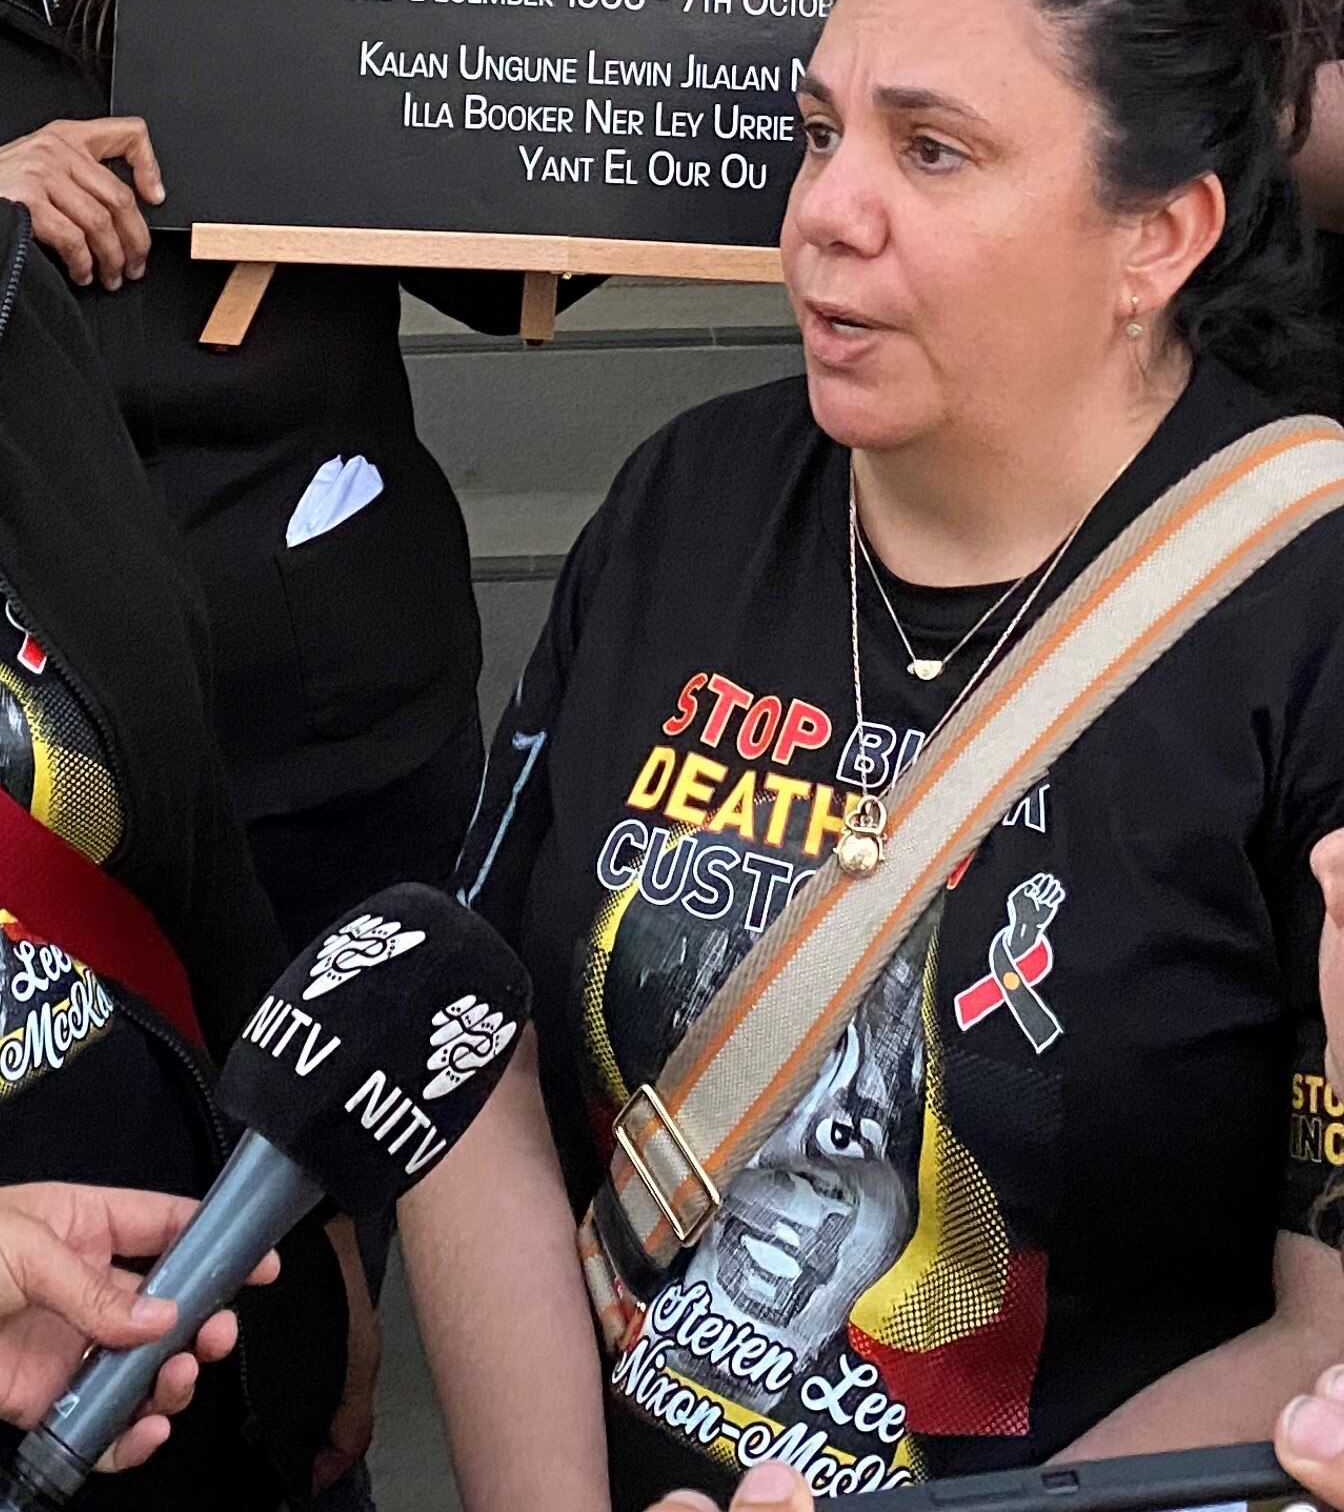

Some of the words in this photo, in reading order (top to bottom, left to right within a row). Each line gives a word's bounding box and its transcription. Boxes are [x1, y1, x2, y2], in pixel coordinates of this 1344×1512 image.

[663, 671, 833, 766] STOP
[625, 744, 863, 860] DEATH
[596, 818, 819, 934] CUST
[242, 995, 341, 1077] NITV
[344, 1069, 446, 1175] NITV
[650, 1280, 795, 1391] Steven
[800, 1353, 908, 1444] Lee
